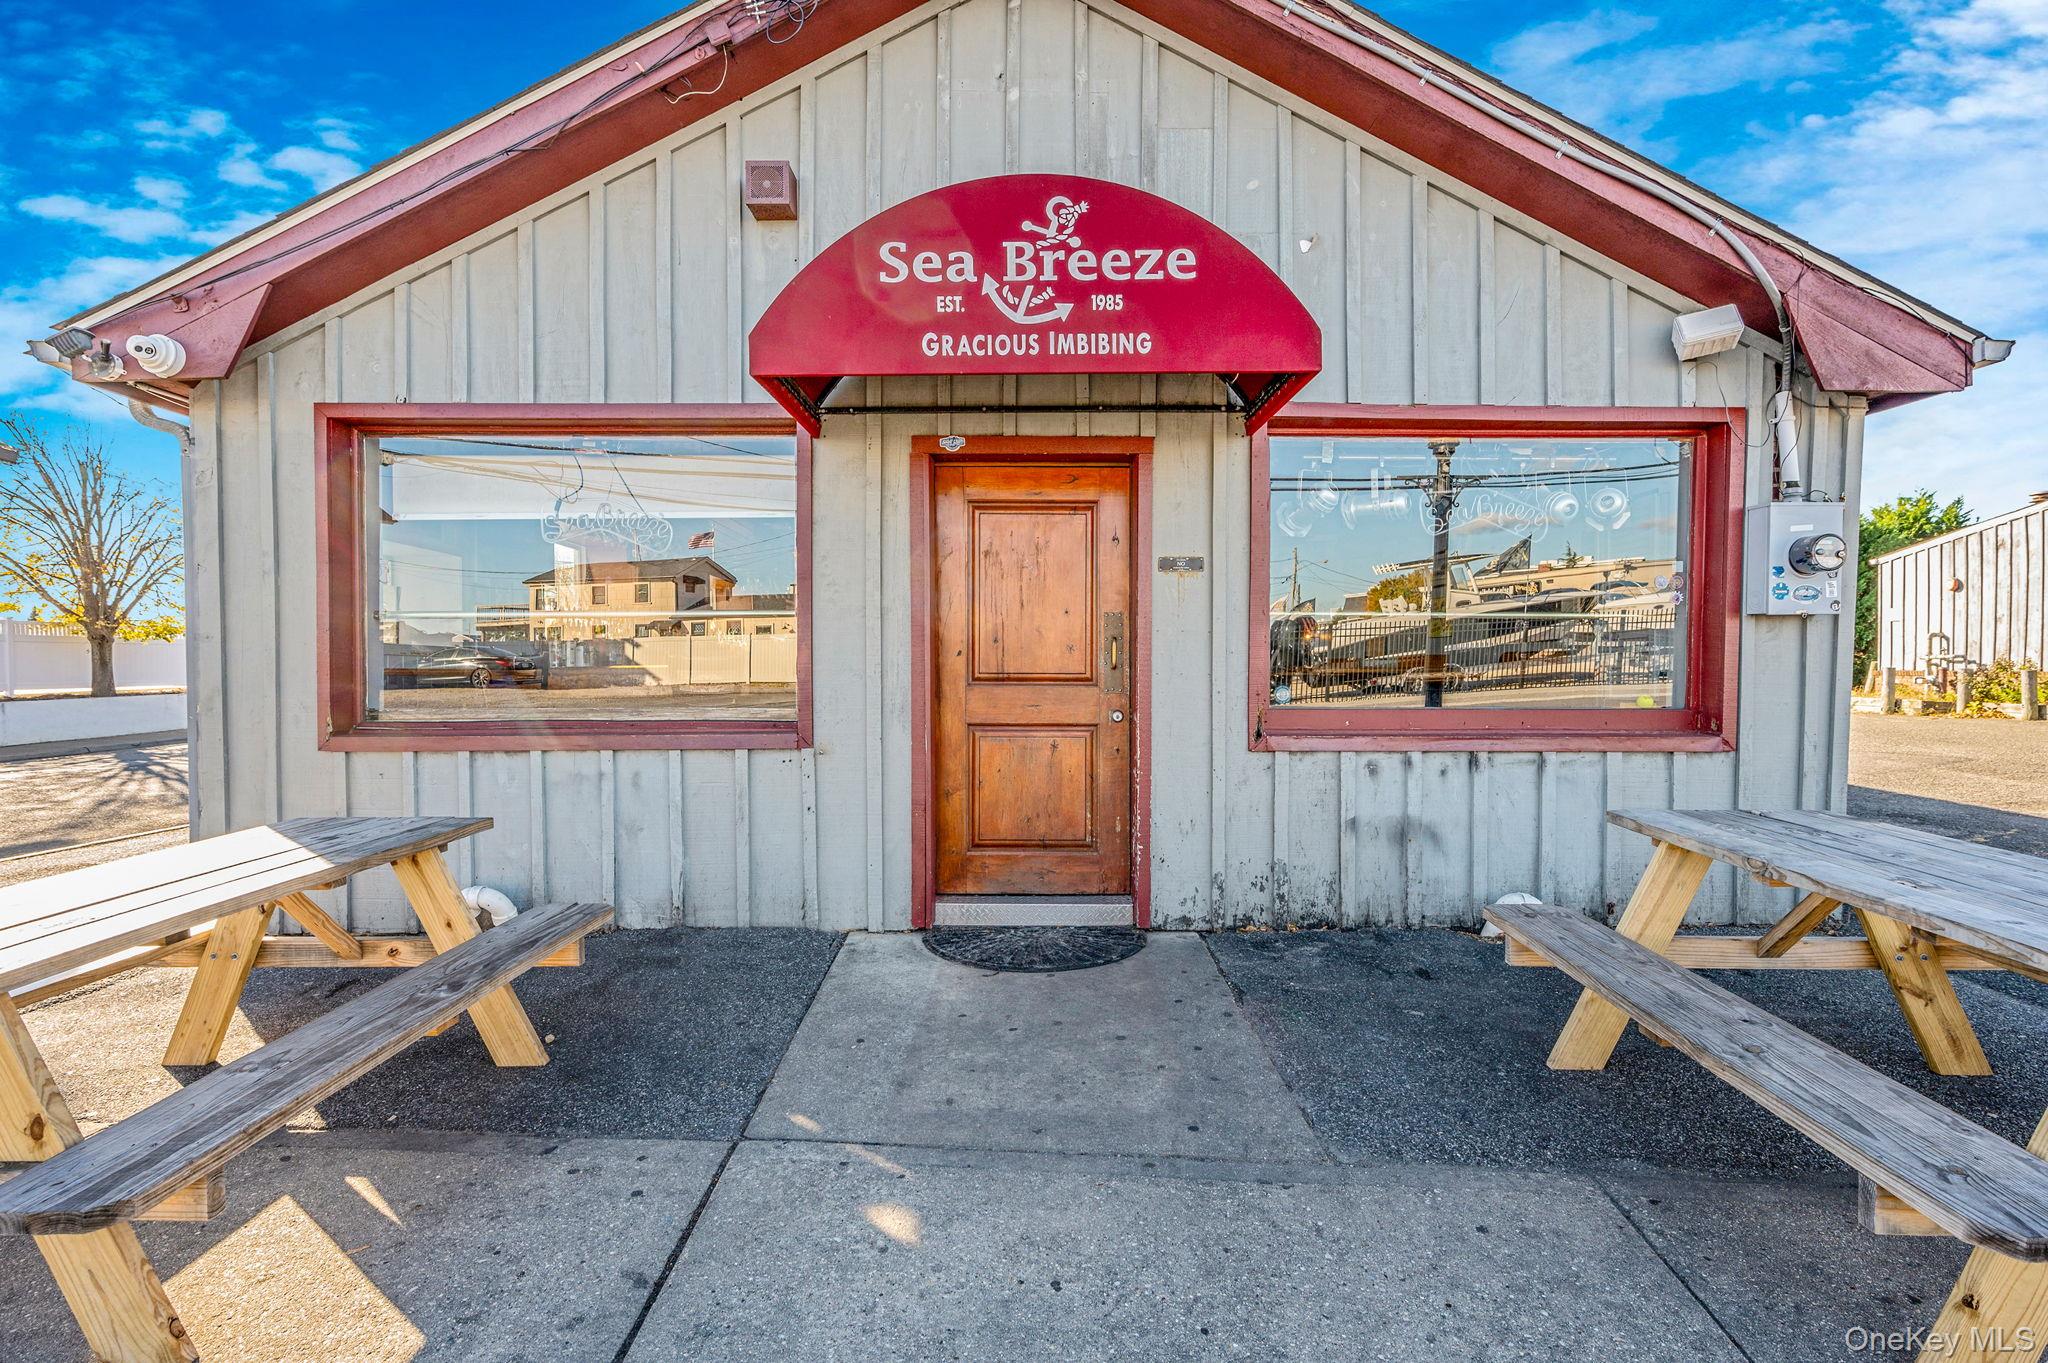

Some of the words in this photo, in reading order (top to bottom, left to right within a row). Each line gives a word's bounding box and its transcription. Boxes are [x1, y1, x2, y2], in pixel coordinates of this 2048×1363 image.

[879, 241, 977, 284] Sea
[1002, 241, 1197, 283] Breeze
[936, 295, 966, 313] EST.
[1091, 294, 1124, 311] 1985
[922, 331, 1040, 357] GRACIOUS
[1049, 330, 1152, 355] IMBIBING
[595, 502, 668, 543] Breeze
[1475, 494, 1545, 532] Breeze
